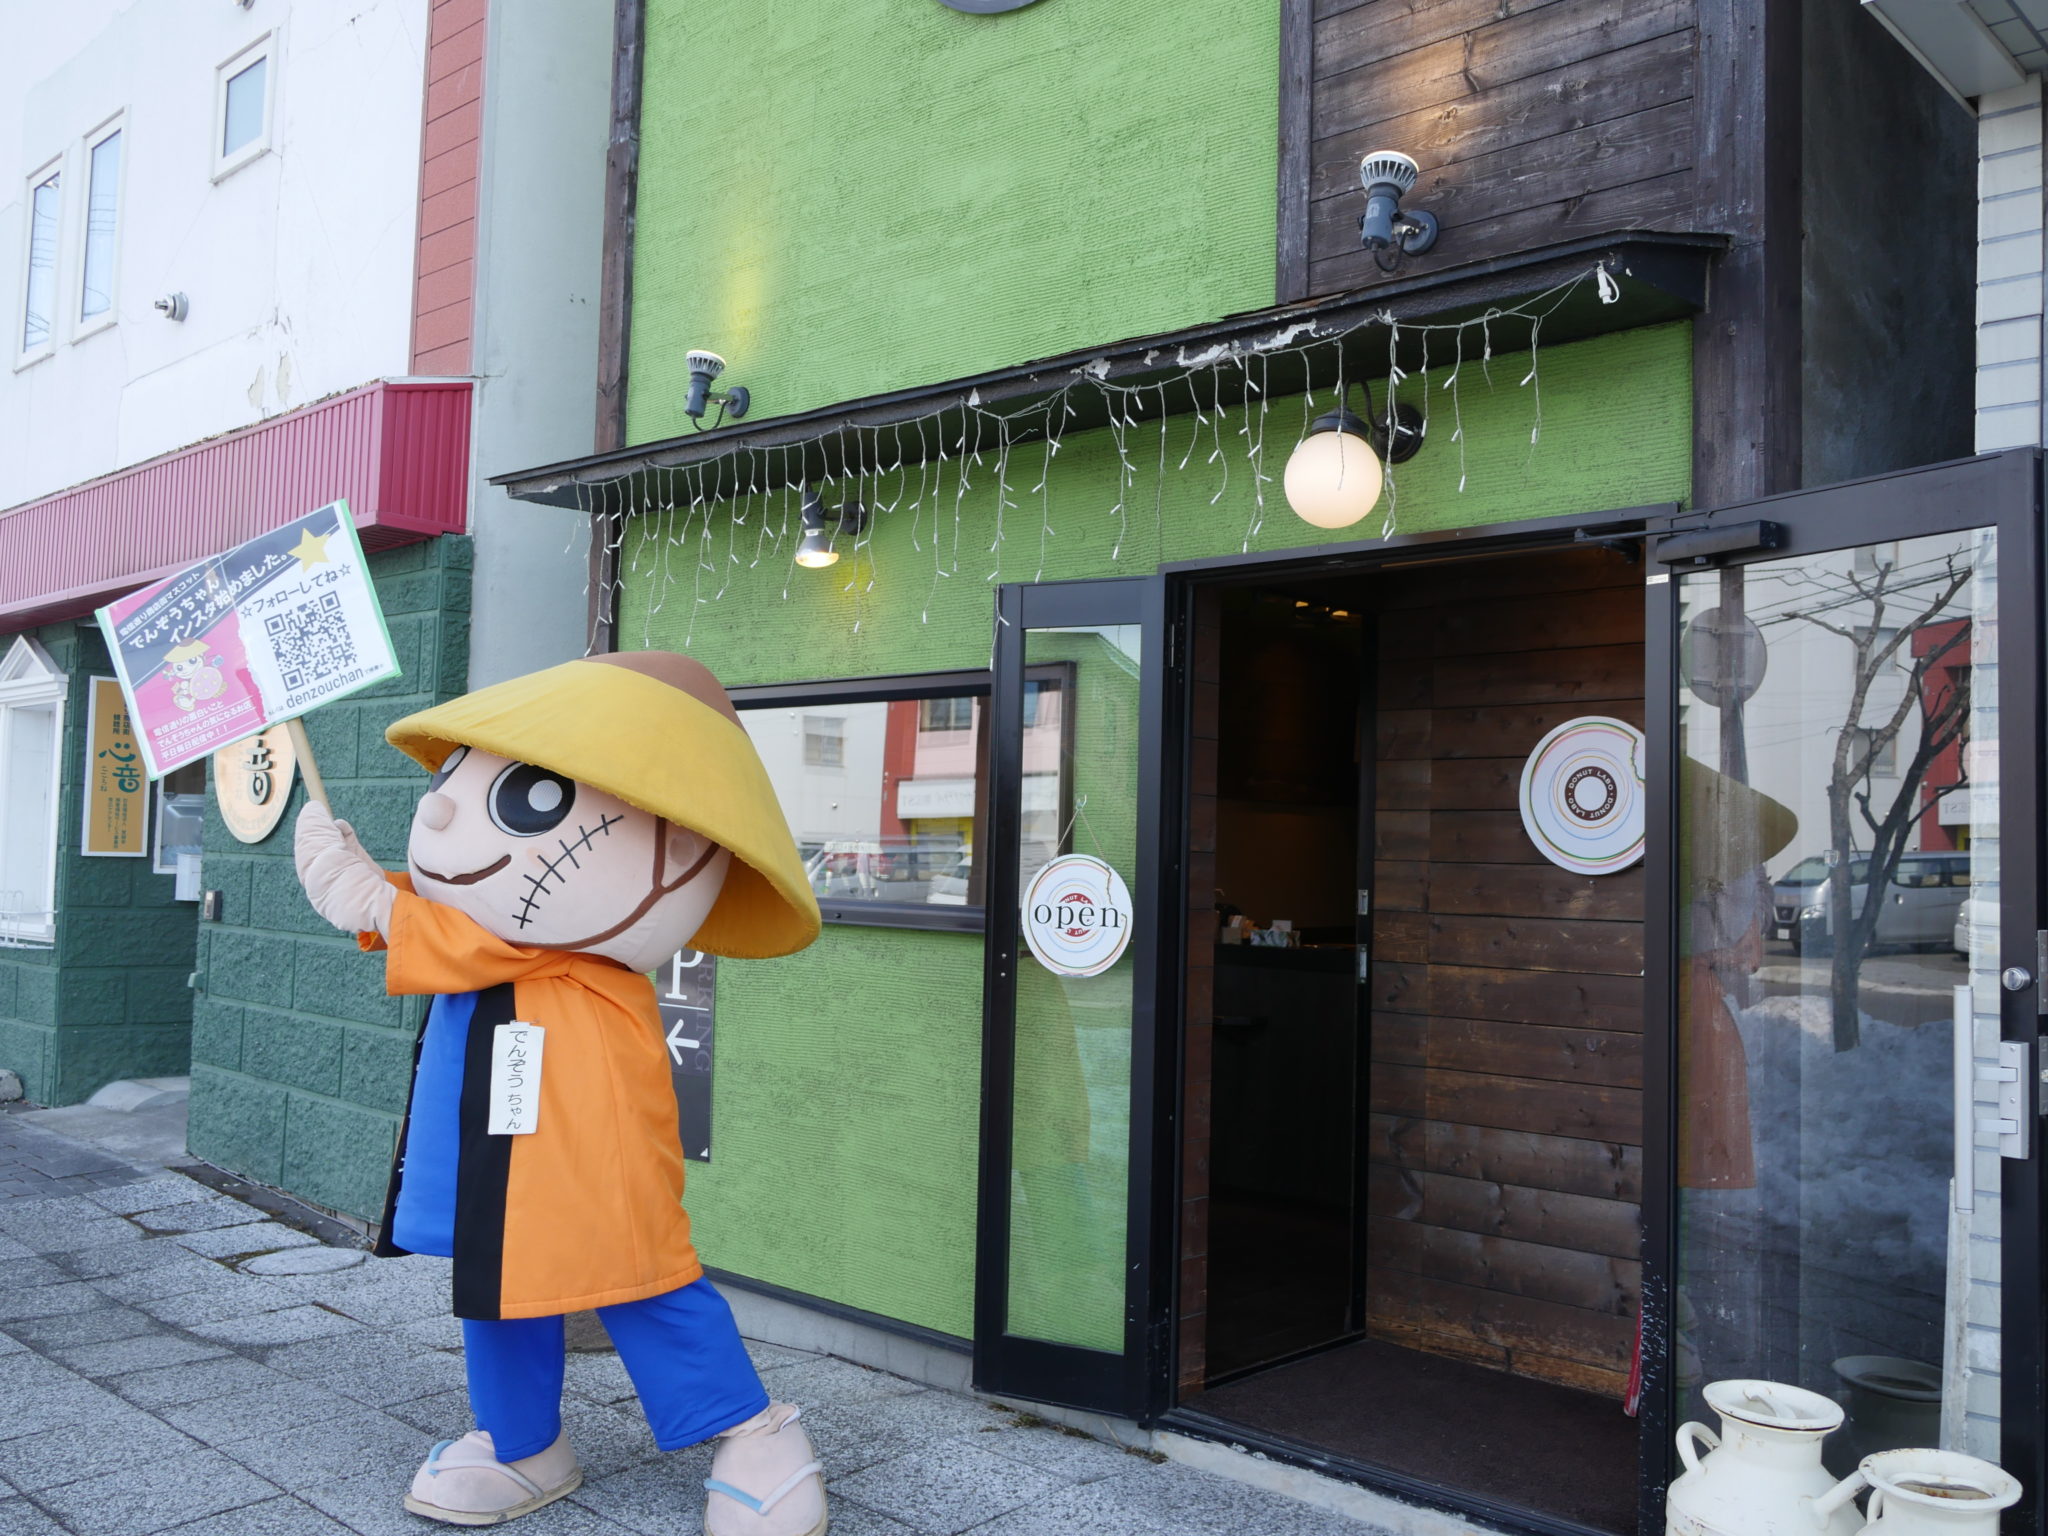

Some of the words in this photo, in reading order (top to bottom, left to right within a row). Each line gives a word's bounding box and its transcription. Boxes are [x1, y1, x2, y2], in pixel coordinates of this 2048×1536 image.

[129, 578, 220, 650] でんぞうちゃん
[169, 552, 288, 645] インスタ始めました。
[286, 668, 365, 709] denzouchan
[1568, 768, 1593, 789] DONUT
[1596, 770, 1614, 791] LABO
[1568, 797, 1586, 817] LABO
[1589, 797, 1614, 818] DONUT
[1034, 903, 1121, 930] open
[665, 950, 704, 1000] P
[694, 962, 714, 1072] RKING
[507, 1029, 529, 1130] でんぞうちゃん
